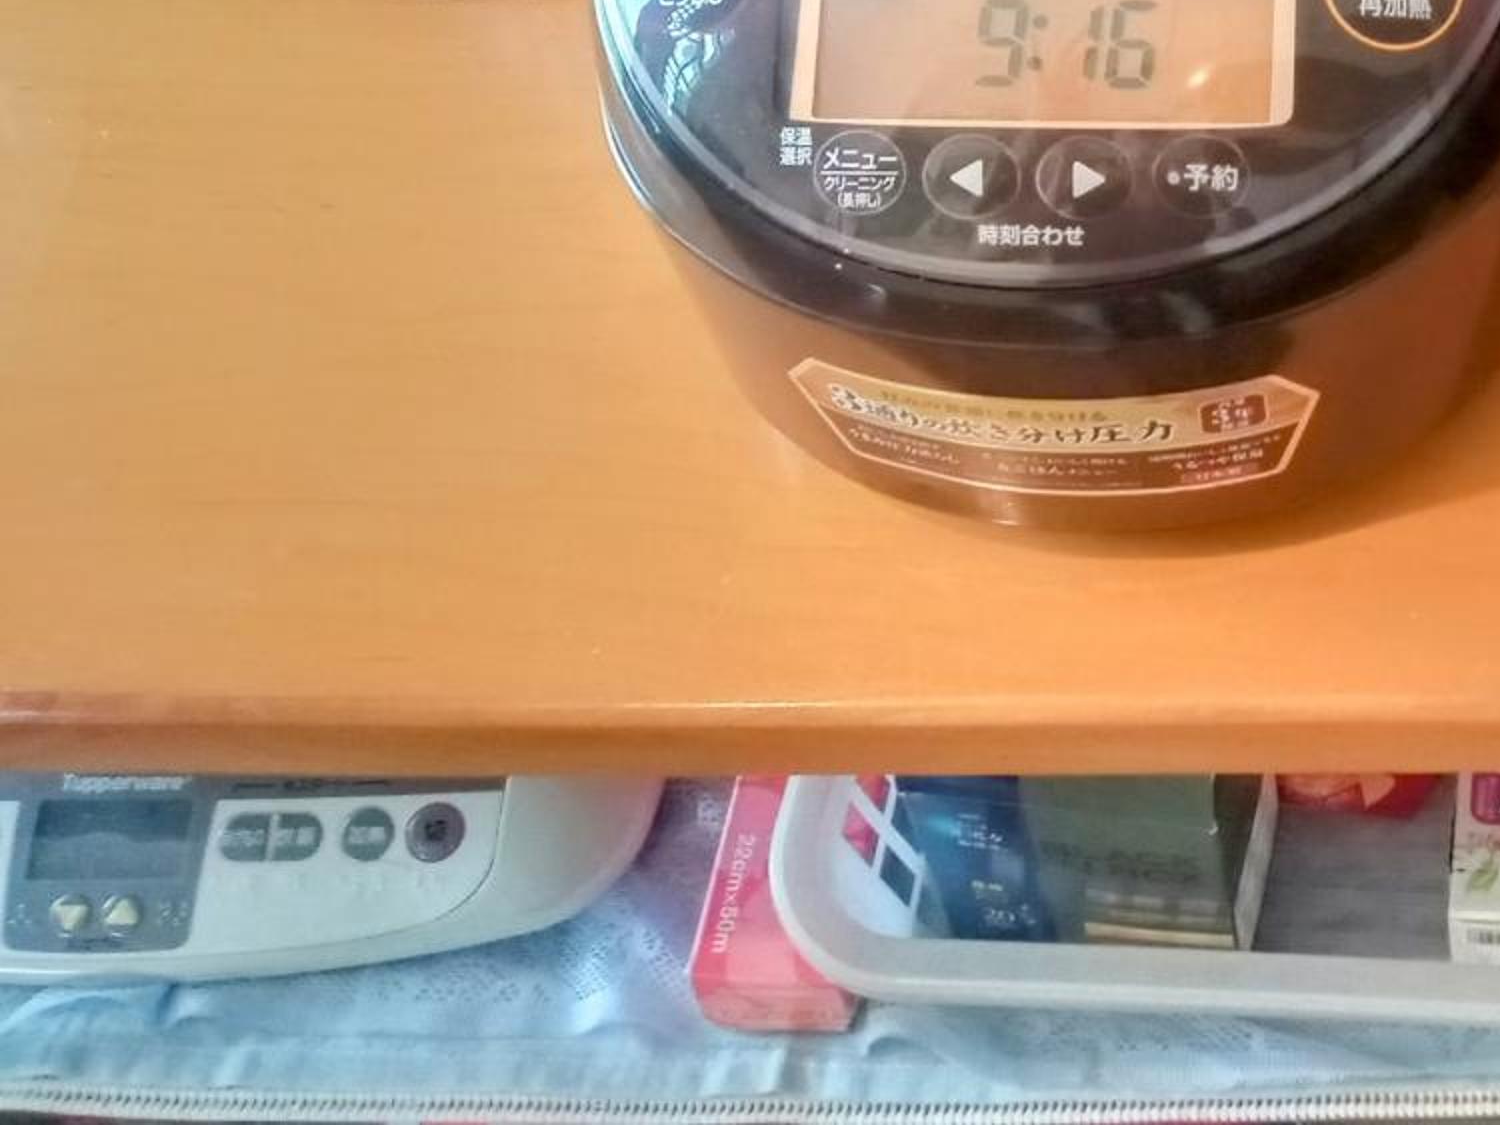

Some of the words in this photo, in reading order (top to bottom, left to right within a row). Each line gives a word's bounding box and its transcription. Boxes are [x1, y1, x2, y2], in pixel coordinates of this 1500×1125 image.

[779, 127, 813, 147] 保温
[779, 147, 813, 166] 選択
[823, 148, 899, 169] メニュー
[823, 176, 896, 192] クリーニング
[1183, 163, 1239, 191] 予約
[976, 223, 1085, 247] 時刻合わせ
